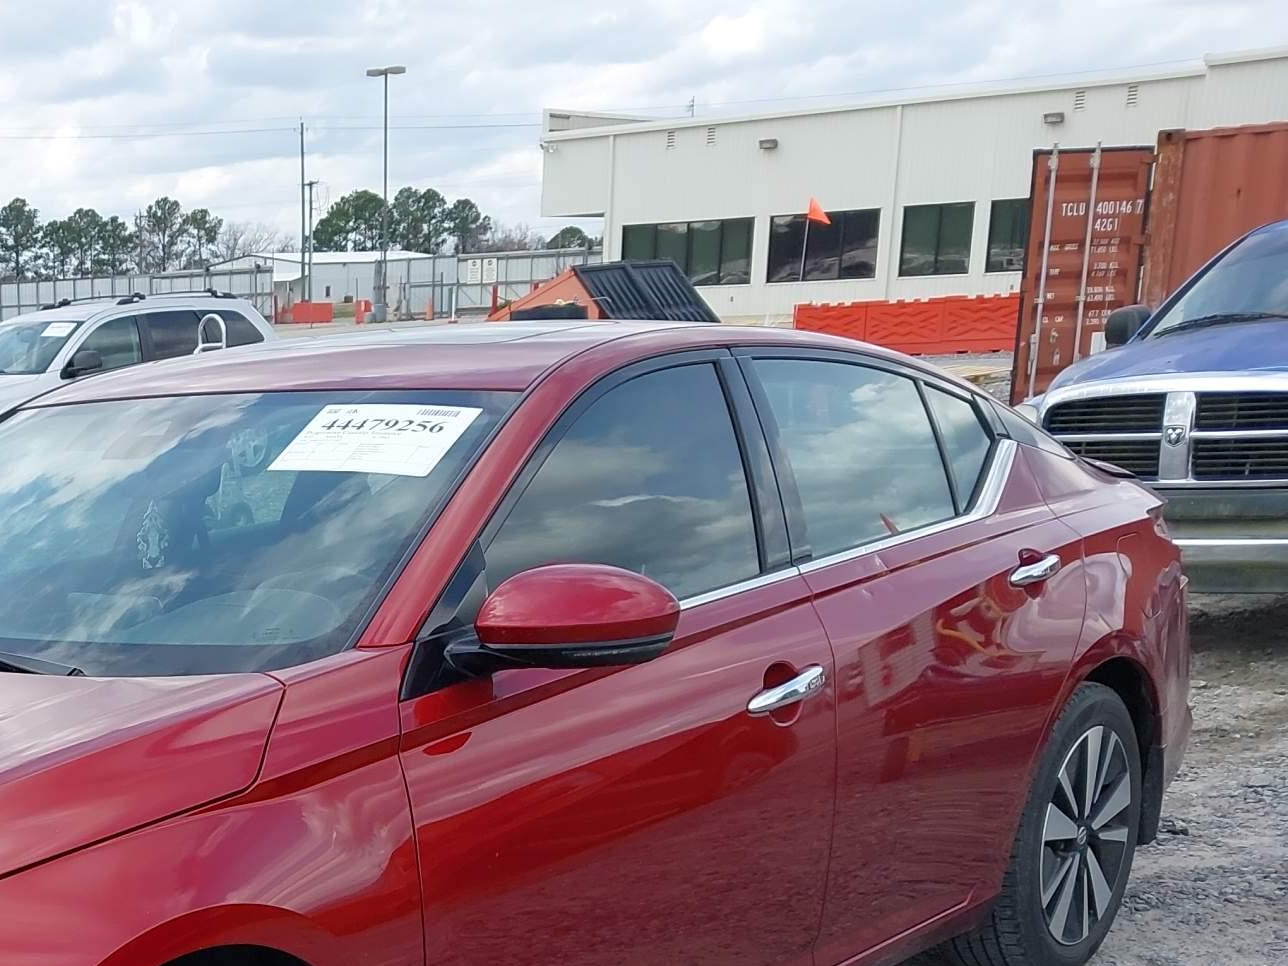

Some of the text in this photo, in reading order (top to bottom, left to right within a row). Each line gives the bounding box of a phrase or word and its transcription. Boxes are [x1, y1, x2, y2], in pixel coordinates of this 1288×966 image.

[1061, 202, 1086, 217] TCLU
[1096, 200, 1133, 215] 400146
[1094, 217, 1119, 232] 42G1
[321, 418, 447, 433] 44479256
